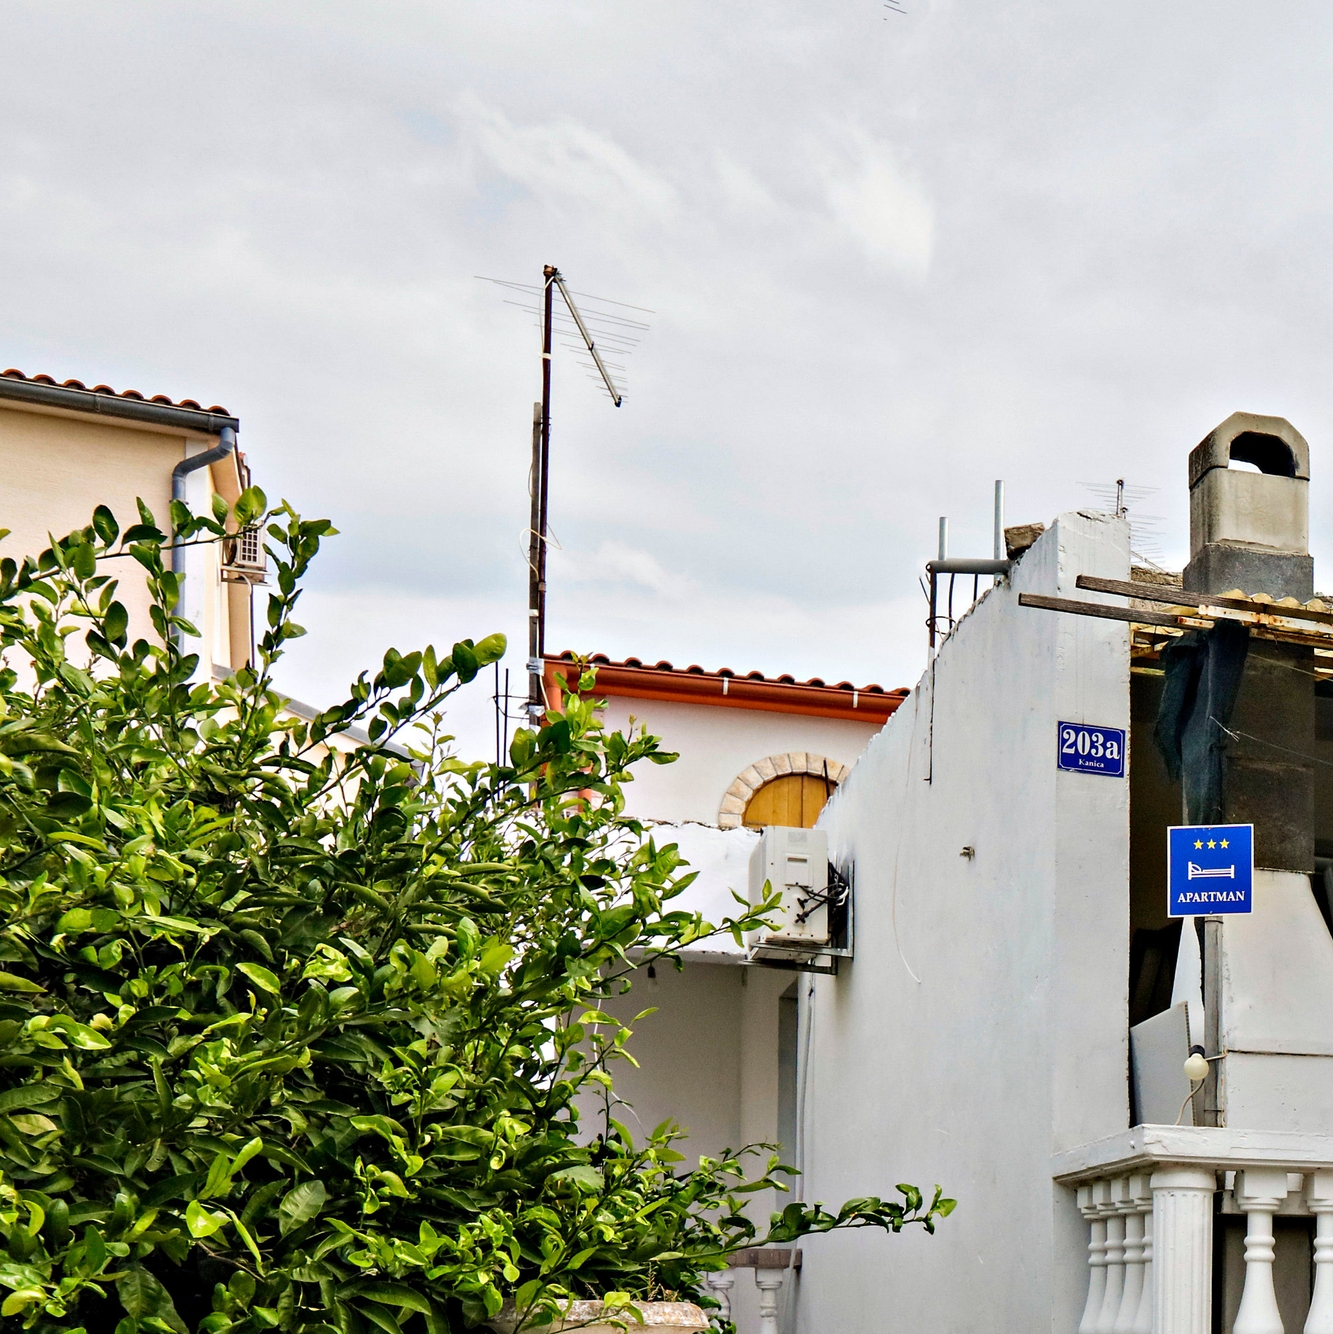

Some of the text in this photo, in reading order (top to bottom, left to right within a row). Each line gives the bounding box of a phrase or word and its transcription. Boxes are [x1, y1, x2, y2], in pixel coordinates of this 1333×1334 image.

[1062, 729, 1120, 759] 203a
[1079, 758, 1104, 768] Kanica
[1177, 891, 1245, 903] APARTMAN
